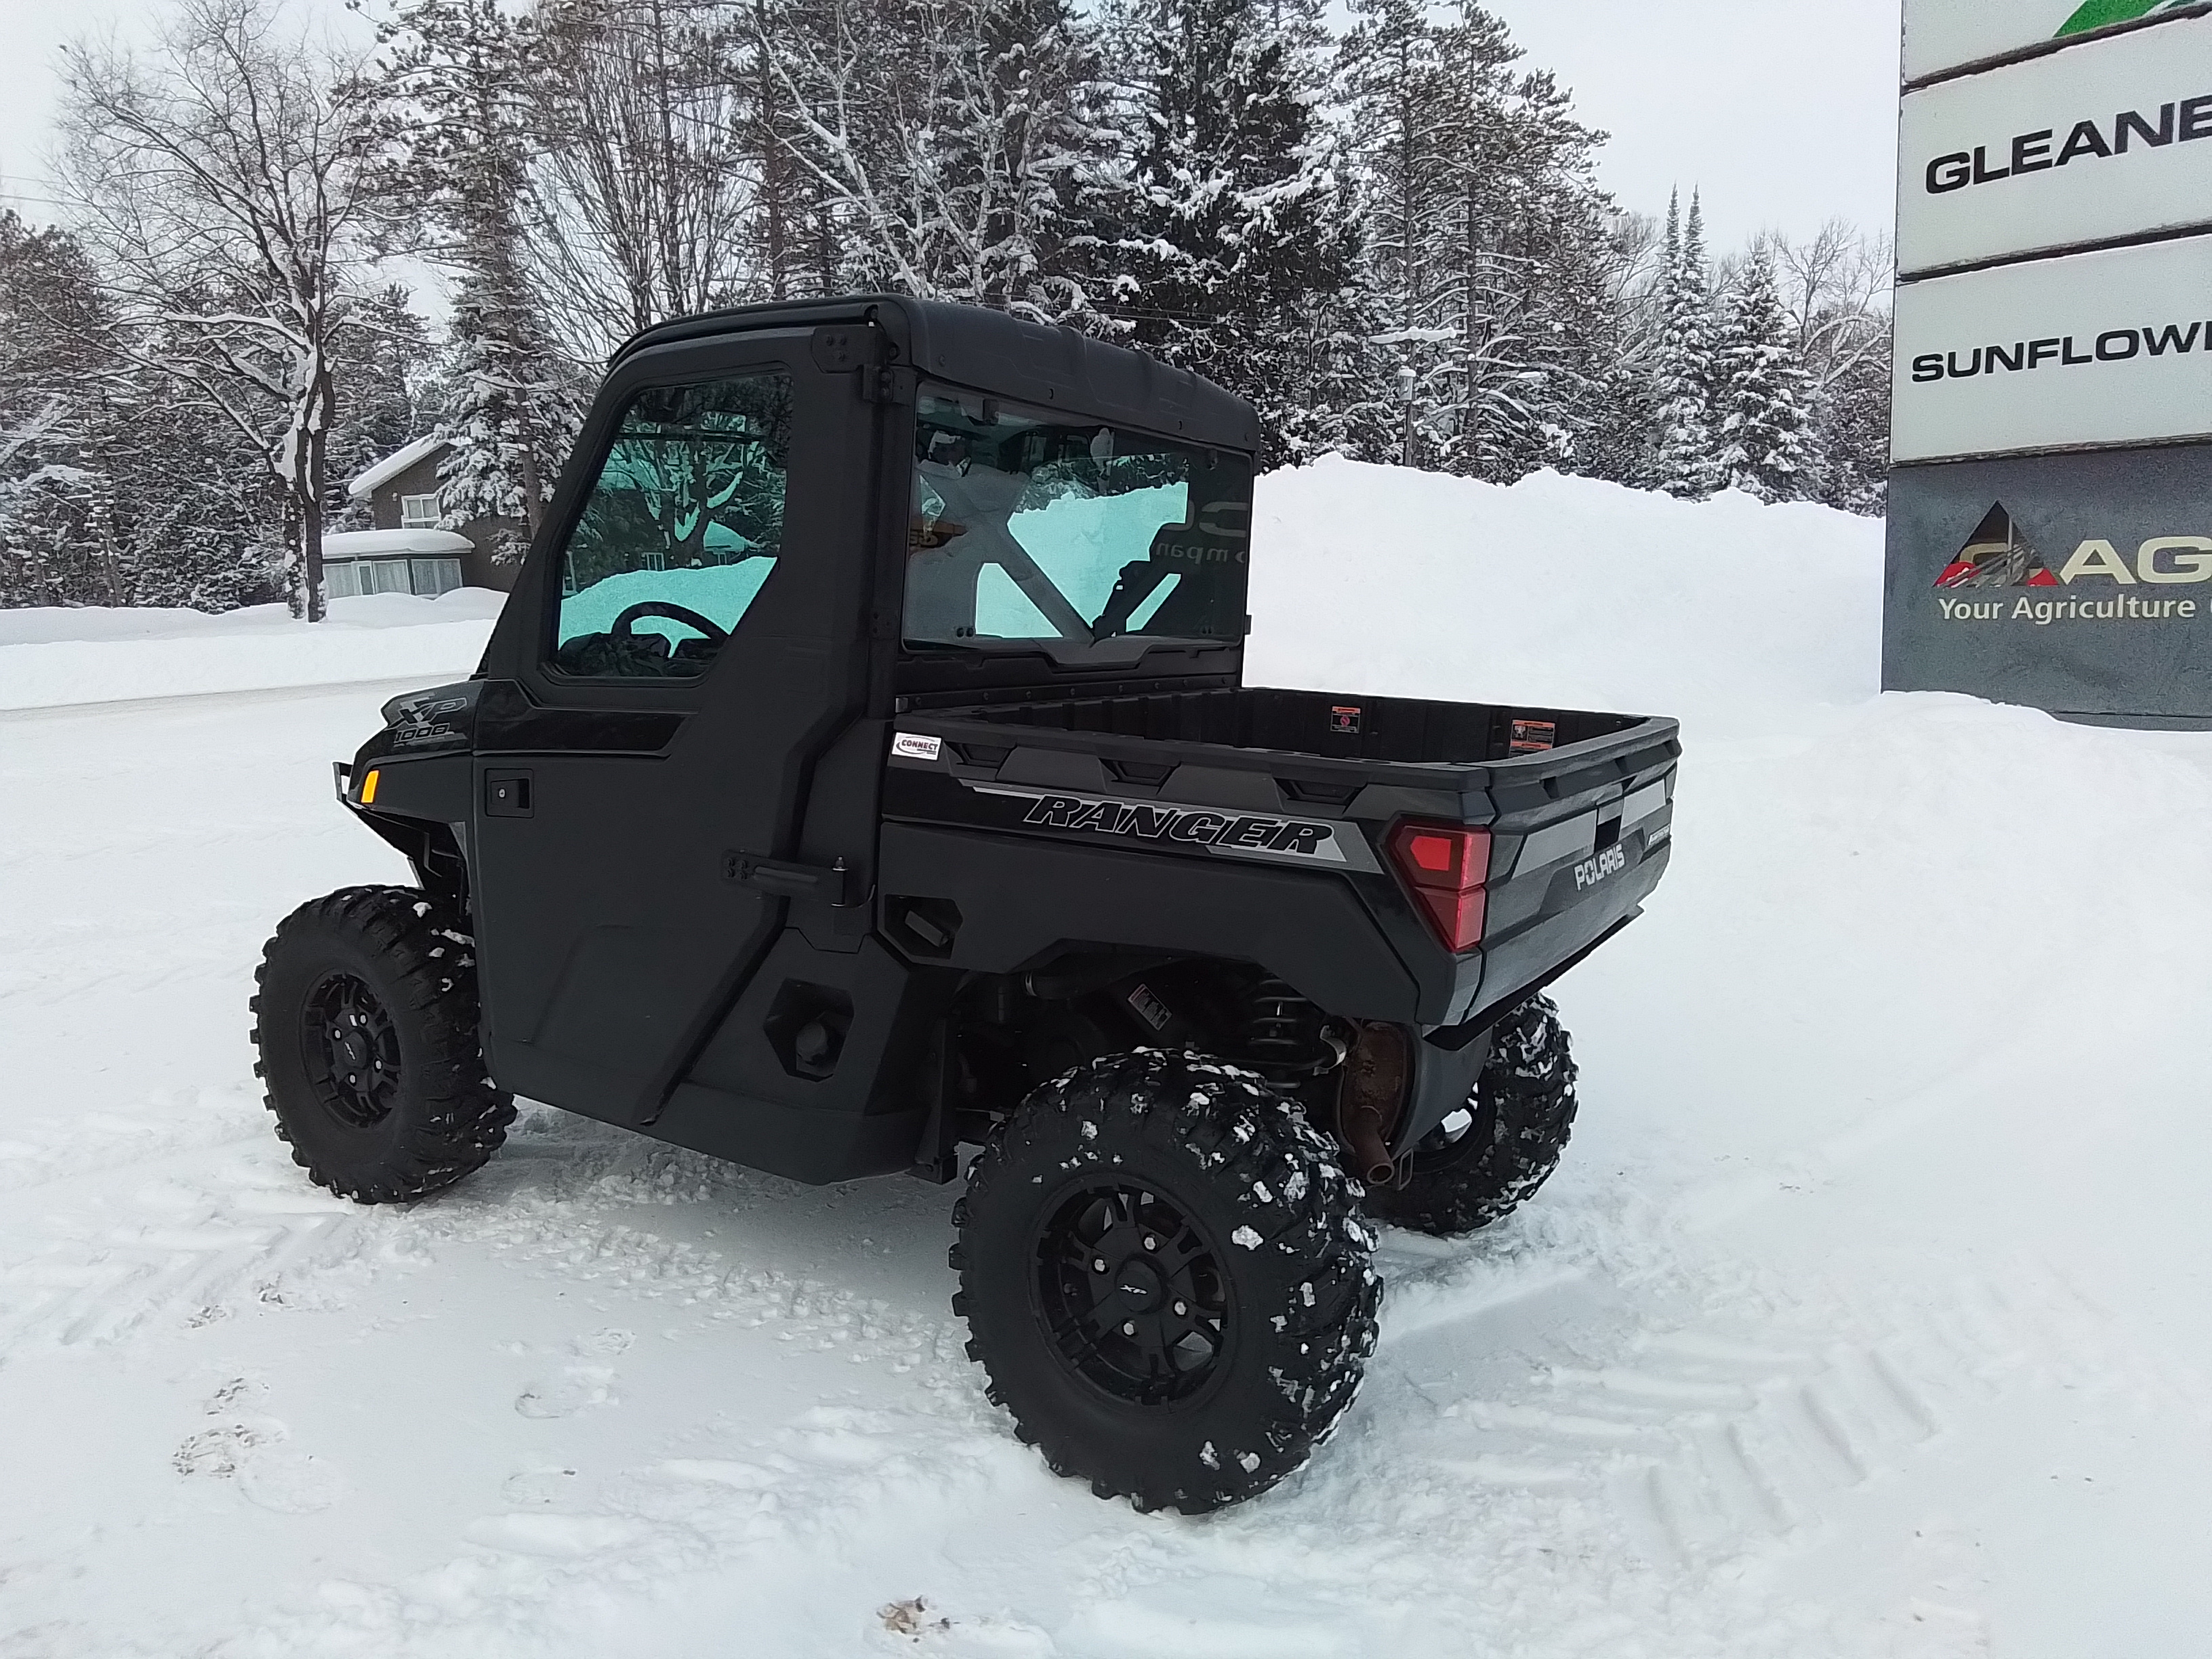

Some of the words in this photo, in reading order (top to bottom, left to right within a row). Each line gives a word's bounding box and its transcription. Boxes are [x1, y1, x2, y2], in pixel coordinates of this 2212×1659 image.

[1926, 94, 2212, 194] GLEANE
[1912, 321, 2212, 382] SUNFLOW
[2058, 536, 2212, 586] AG
[1939, 598, 2003, 619] Your
[2011, 594, 2195, 625] Agriculture
[388, 697, 468, 729] XP
[901, 739, 939, 751] CONNECT
[1023, 794, 1335, 855] RANGER
[1574, 843, 1625, 891] POLARIS
